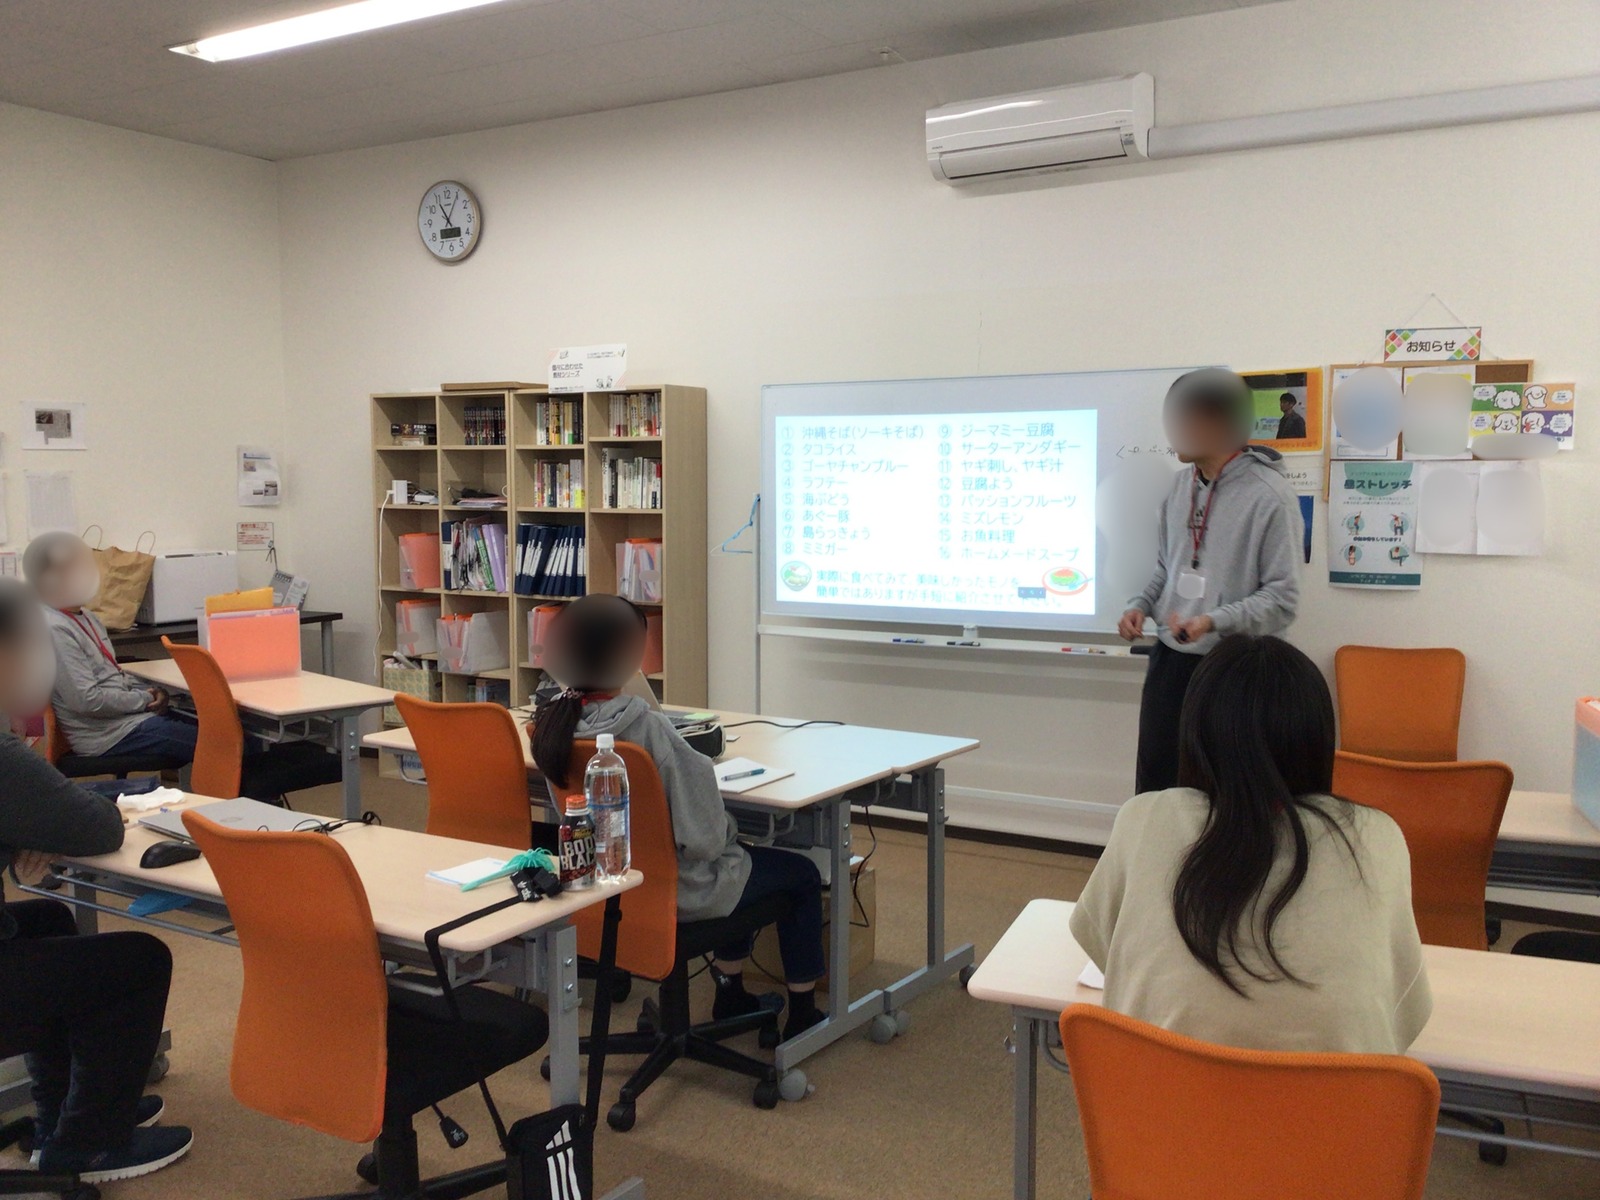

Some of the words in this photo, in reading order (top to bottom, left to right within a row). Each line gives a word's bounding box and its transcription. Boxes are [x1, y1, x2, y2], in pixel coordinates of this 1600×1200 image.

[443, 190, 451, 199] 12
[429, 205, 436, 214] 10
[462, 200, 468, 209] 2
[427, 219, 432, 228] 9
[466, 214, 472, 223] 3
[432, 233, 437, 242] 8
[465, 228, 470, 236] 4
[440, 241, 444, 250] 7
[449, 242, 454, 252] 6
[459, 238, 464, 247] 5
[1406, 340, 1456, 352] お知らせ
[961, 422, 1055, 437] ジーマミー豆腐
[802, 443, 856, 456] タコライス
[962, 440, 1081, 454] サーターアンダギー
[961, 459, 1063, 472] ヤギ刺し、ヤギ汁
[802, 476, 848, 488] ラフテー
[962, 476, 1014, 490] 豆腐よう
[802, 493, 849, 506] 海ぶどう
[961, 494, 1076, 508] パッションフルーツ
[802, 510, 850, 522] あぐー豚
[961, 511, 1024, 525] ミズレモン
[802, 526, 871, 540] 島らっきょう
[961, 530, 1015, 544] お魚料理
[802, 542, 848, 555] ミミガー
[961, 547, 1080, 560] ホームメードスープ
[560, 850, 596, 870] BLAC
